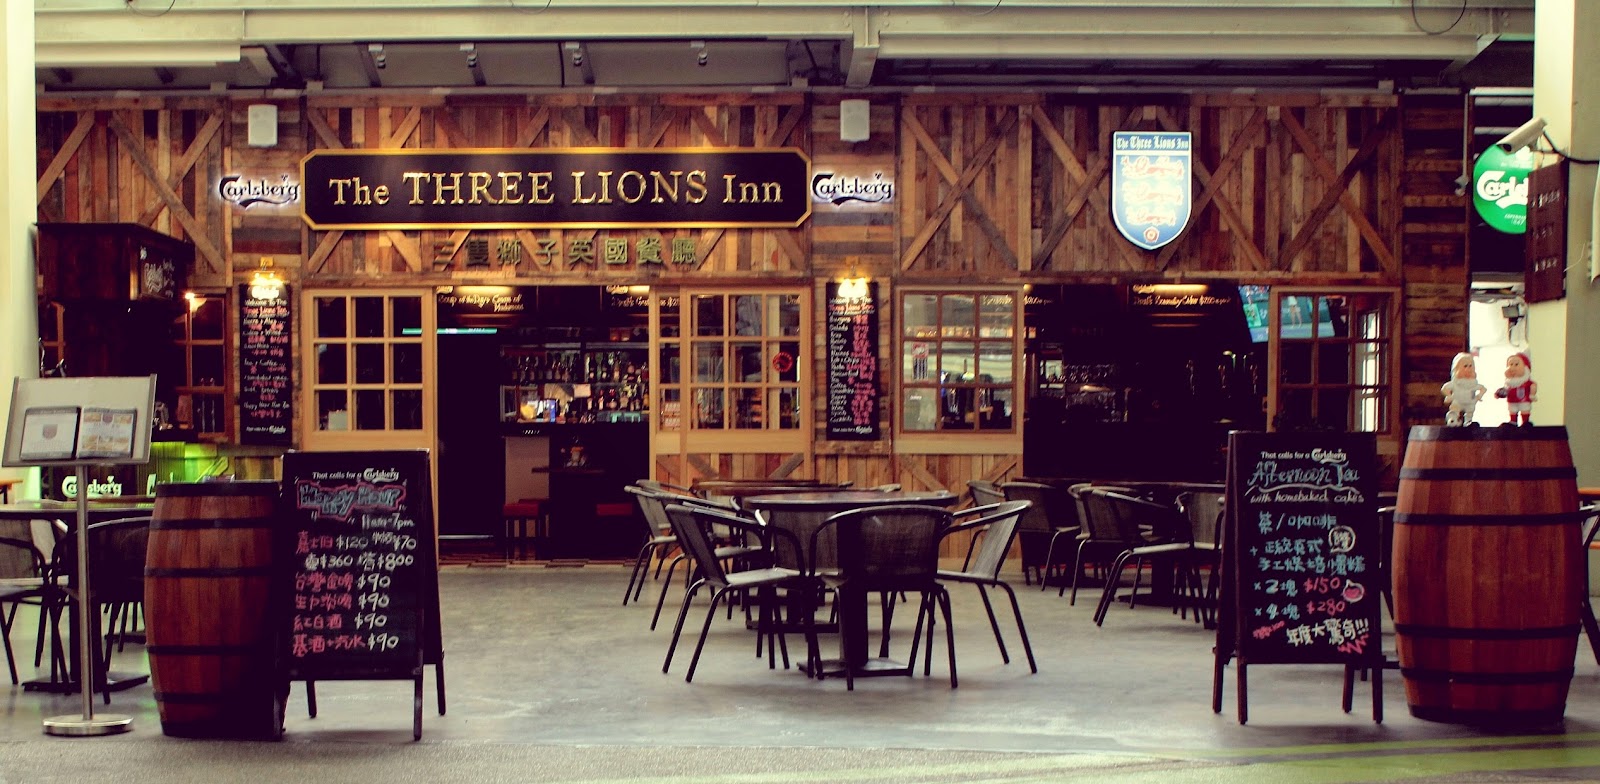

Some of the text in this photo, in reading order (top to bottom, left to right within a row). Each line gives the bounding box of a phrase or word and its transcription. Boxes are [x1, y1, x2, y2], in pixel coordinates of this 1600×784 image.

[1116, 135, 1189, 150] The Three Lions Inn
[218, 174, 300, 210] Carlsberg
[329, 169, 783, 205] The THREE LIONS Inn
[811, 172, 894, 206] Carlsberg
[1476, 170, 1529, 209] Carls
[432, 238, 696, 266] 三隻獅子英國餐廳
[1260, 451, 1277, 459] That
[1277, 451, 1293, 459] calls
[1294, 451, 1305, 459] for
[1311, 447, 1347, 464] Carlsberg
[312, 471, 328, 479] That
[328, 471, 345, 479] calls
[346, 471, 356, 479] for
[363, 467, 400, 484] Carlsberg
[1247, 460, 1360, 487] Afternoon Tea
[61, 474, 122, 498] Casberg
[1250, 489, 1365, 505] with homebaked cakes
[336, 534, 369, 551] $120
[377, 552, 414, 572] $800
[357, 572, 391, 592] $90
[1303, 576, 1340, 594] $150
[358, 592, 390, 611] $90
[1306, 598, 1346, 616] $280
[354, 611, 387, 630] $90
[367, 632, 399, 652] $90
